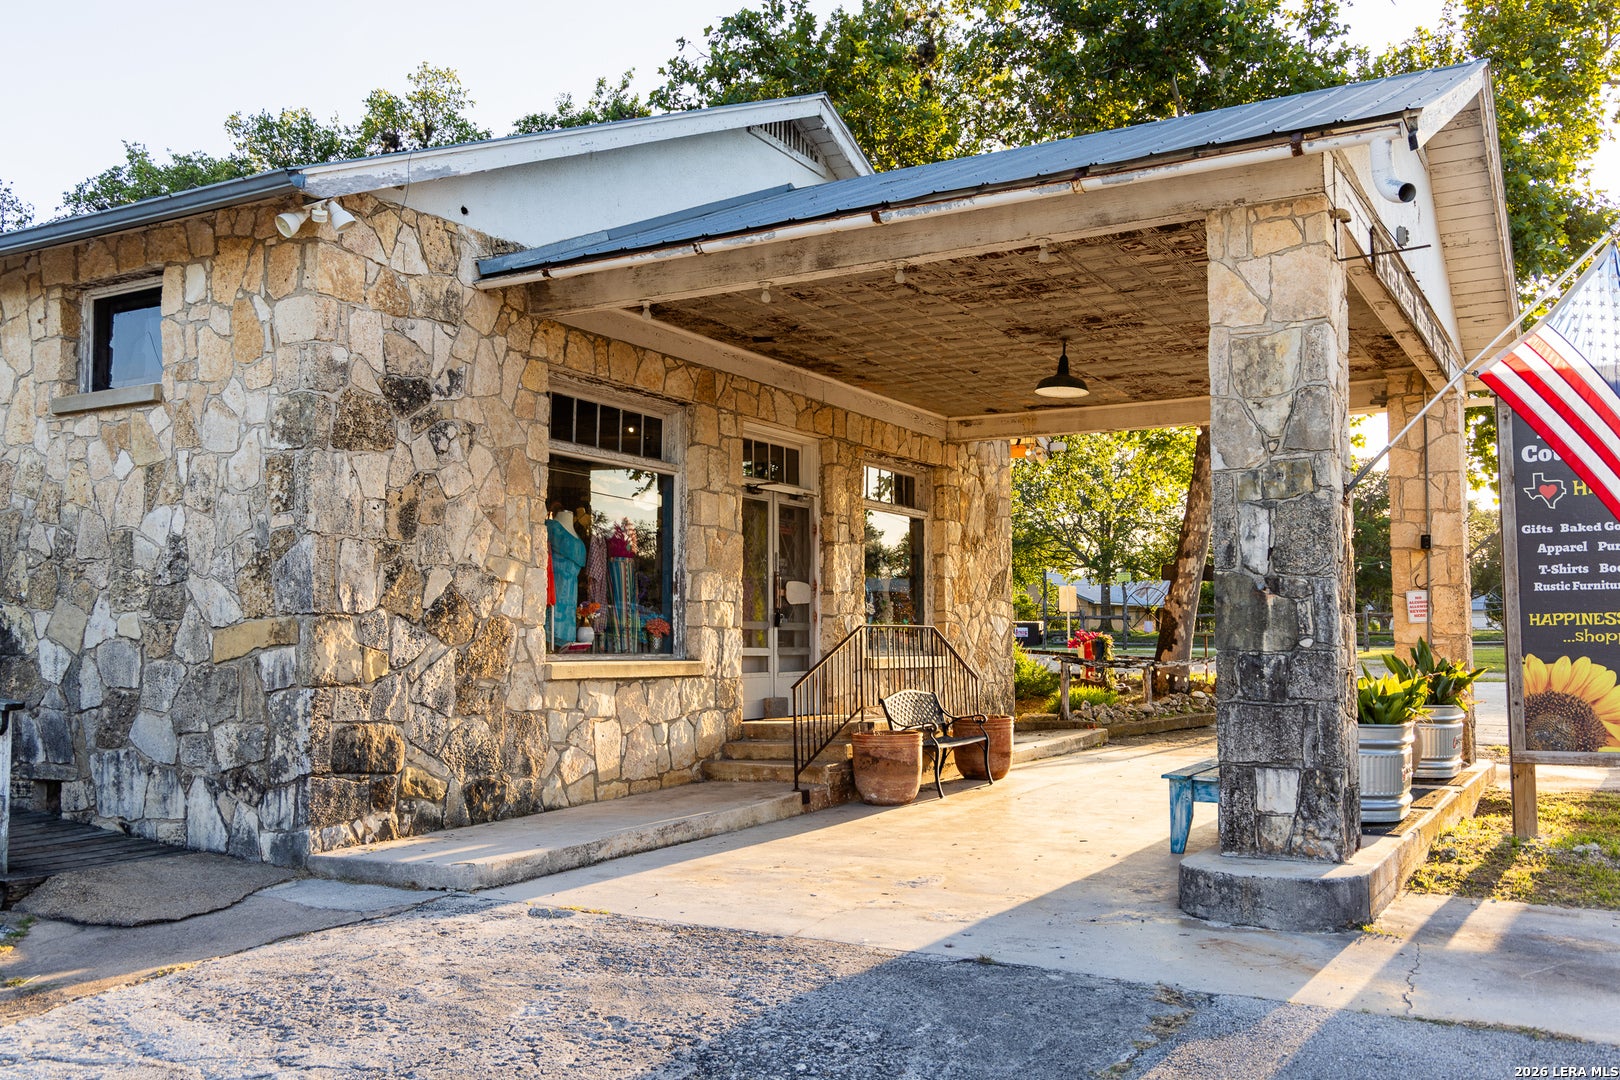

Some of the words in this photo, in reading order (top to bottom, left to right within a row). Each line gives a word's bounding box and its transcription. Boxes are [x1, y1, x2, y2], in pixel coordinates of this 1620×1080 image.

[1521, 524, 1554, 534] Gifts
[1560, 522, 1602, 533] Baked
[1537, 541, 1588, 556] Apparel
[1538, 563, 1589, 575] T-Shirts
[1533, 581, 1571, 592] Rustic
[1528, 612, 1620, 626] HAPPINES
[1563, 628, 1620, 645] ...shop
